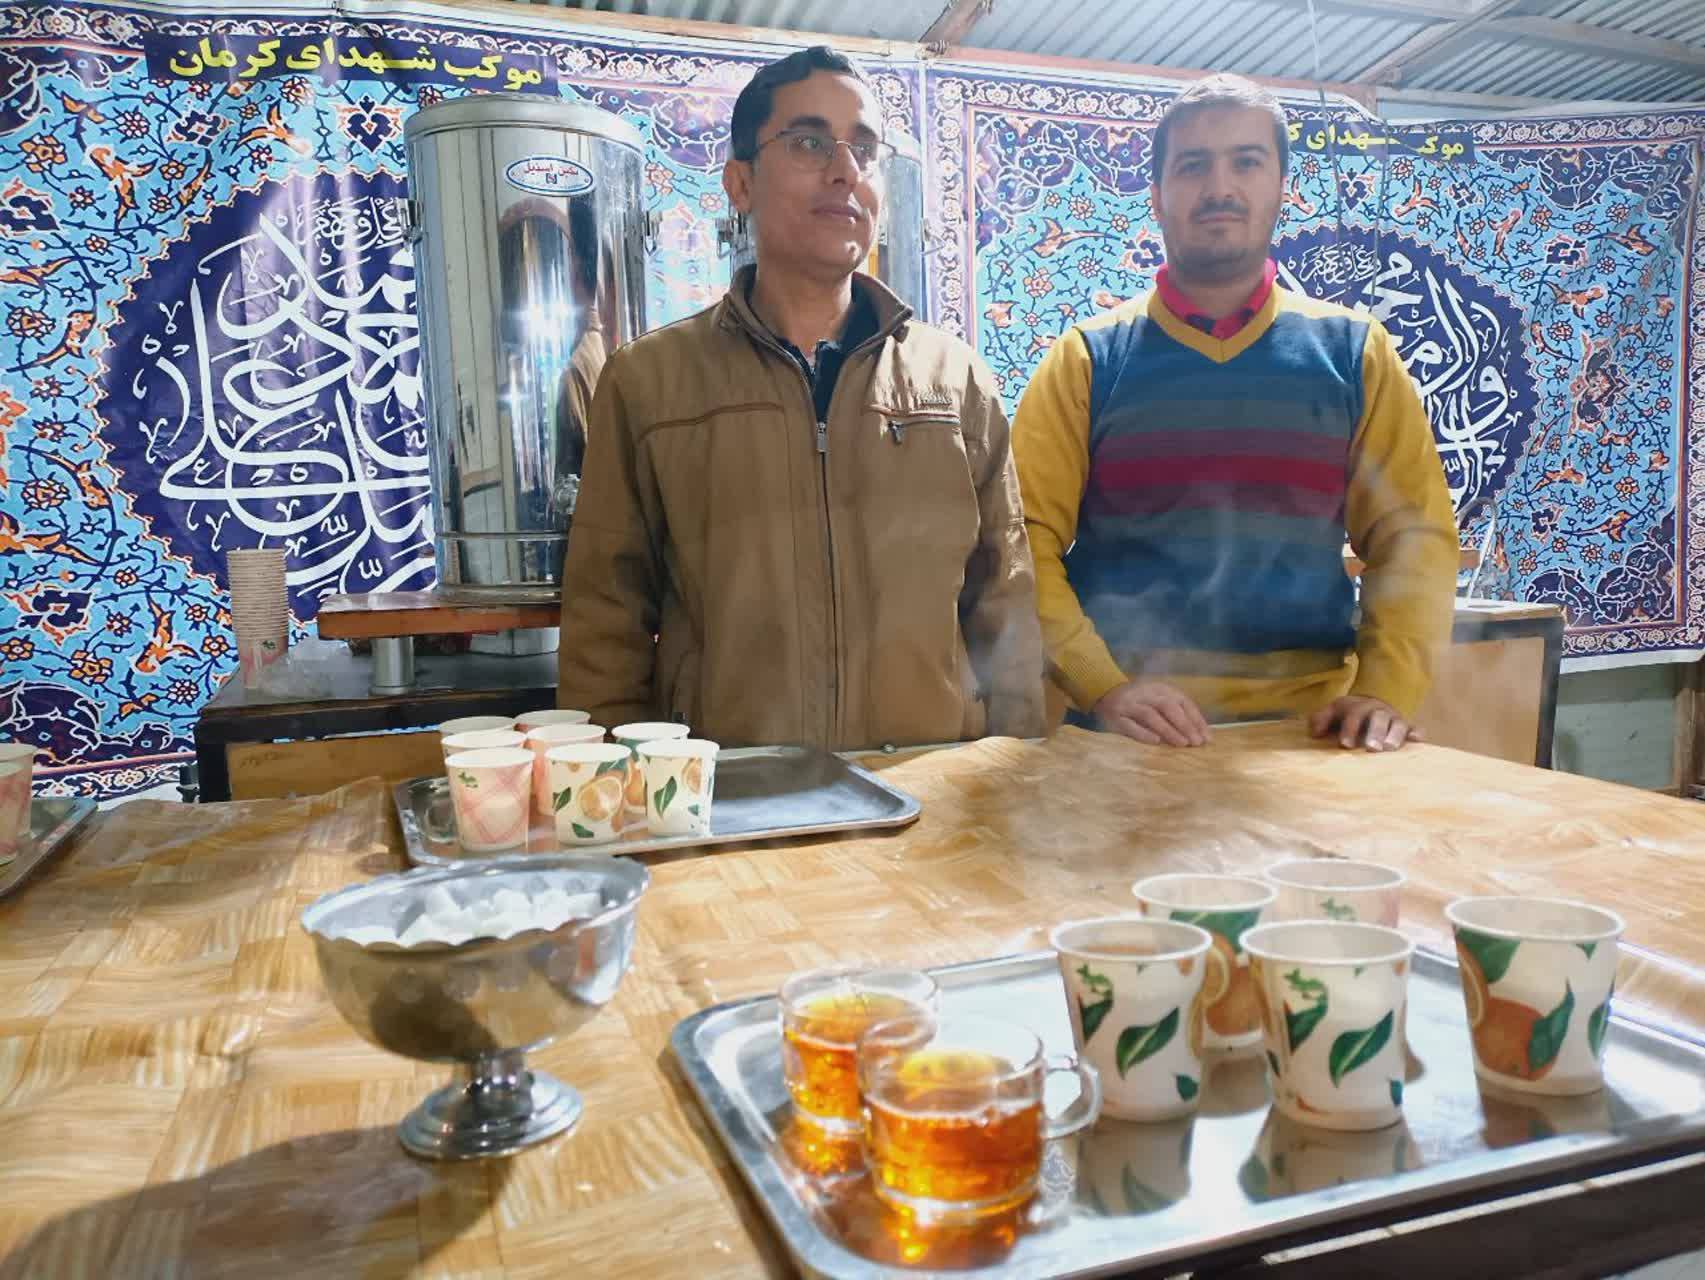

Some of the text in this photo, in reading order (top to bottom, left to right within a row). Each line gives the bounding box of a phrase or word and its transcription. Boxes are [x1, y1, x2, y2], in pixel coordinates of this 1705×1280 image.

[169, 37, 542, 91] موکب شهدای کرمان
